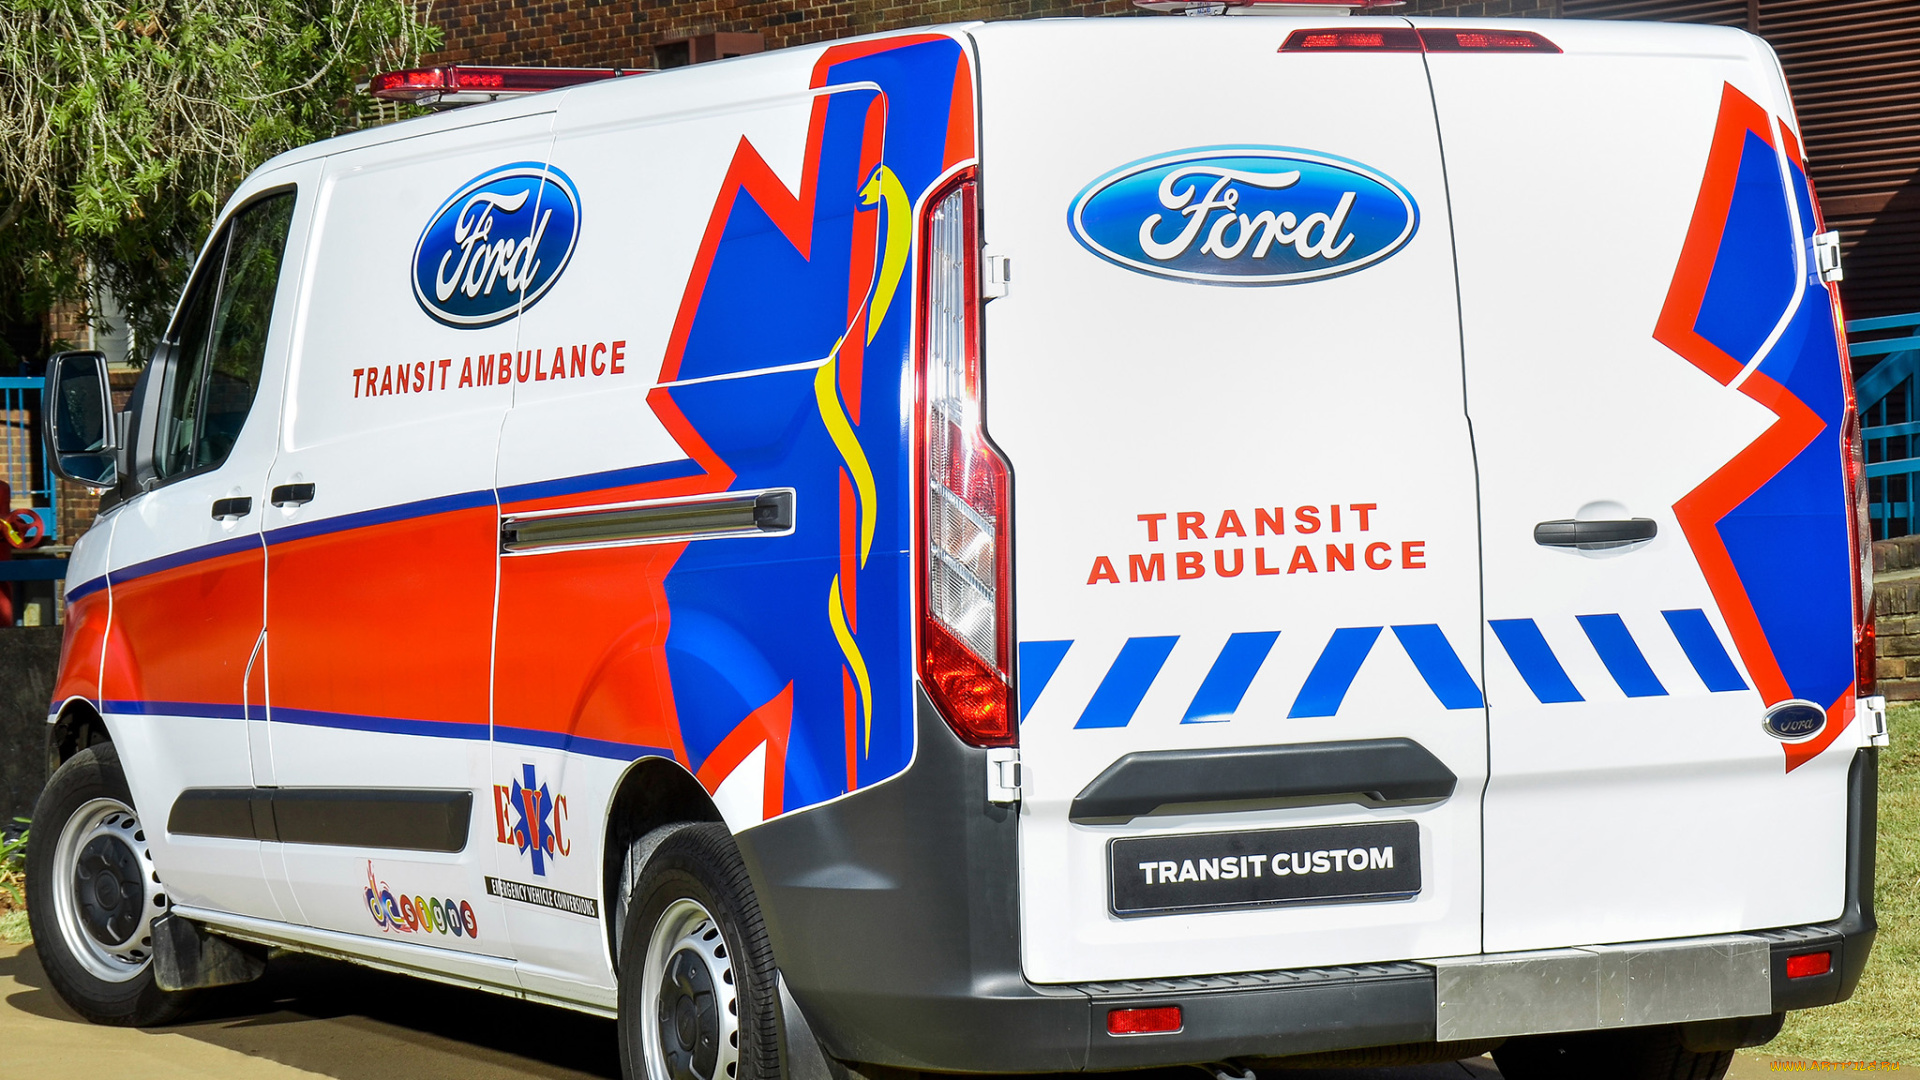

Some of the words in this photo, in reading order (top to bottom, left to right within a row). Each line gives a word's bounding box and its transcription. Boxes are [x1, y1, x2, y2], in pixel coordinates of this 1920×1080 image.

[1139, 166, 1357, 260] Ford
[436, 189, 552, 302] Ford
[353, 359, 452, 398] TRANSIT
[458, 340, 626, 389] AMBULANCE
[1137, 503, 1377, 542] TRANSIT
[1087, 541, 1427, 585] AMBULANCE
[1139, 855, 1267, 885] TRANSIT
[1271, 846, 1394, 875] CUSTOM
[491, 878, 527, 901] EMERGENCY
[527, 886, 554, 907] VEHICLE
[553, 891, 596, 916] CONVERSIONS
